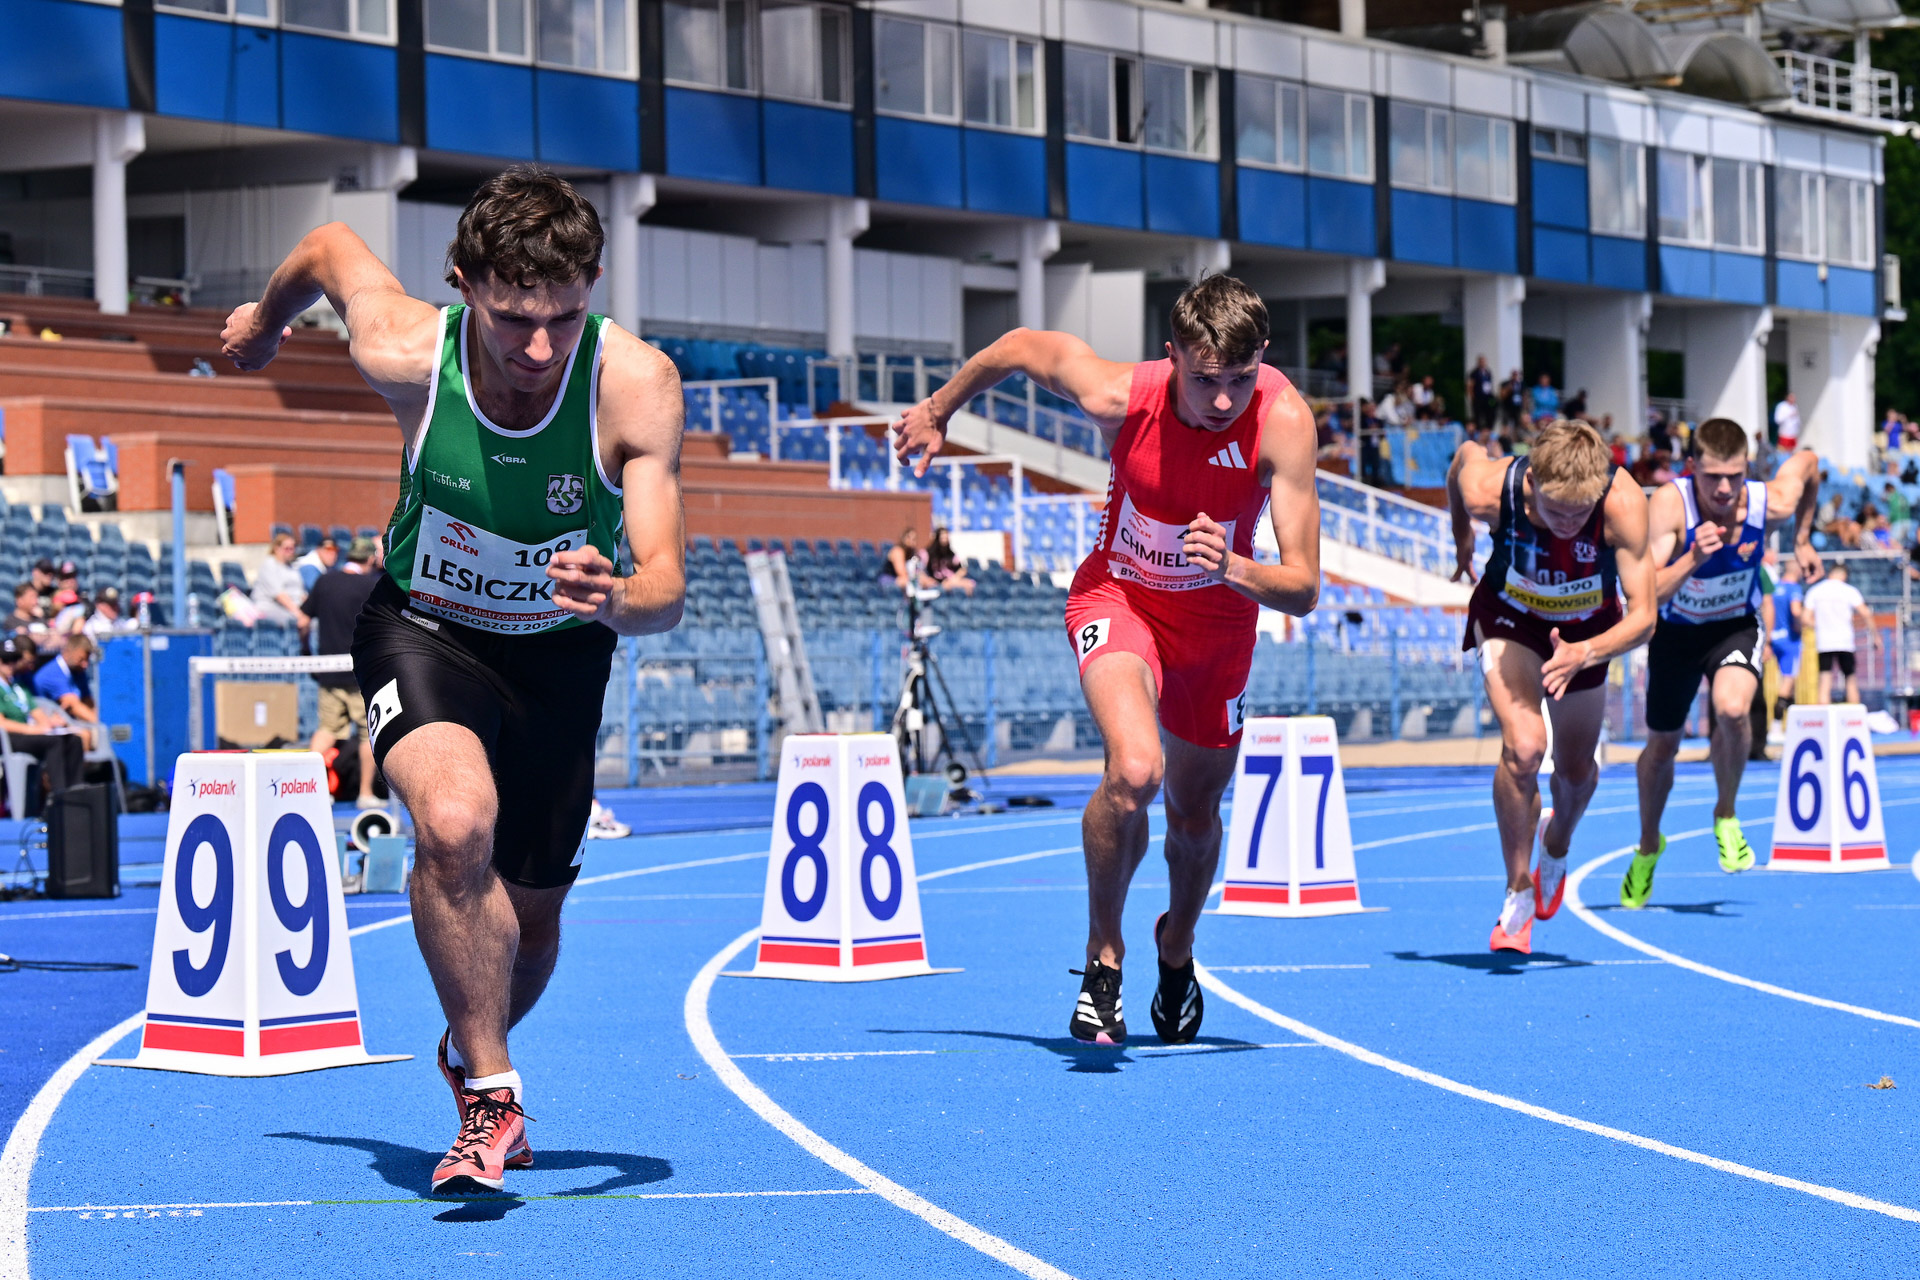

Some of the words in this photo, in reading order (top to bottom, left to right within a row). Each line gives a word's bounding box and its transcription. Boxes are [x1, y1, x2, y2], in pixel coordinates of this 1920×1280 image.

[440, 535, 479, 557] ORLEN
[1120, 527, 1191, 568] CHMIEL
[1120, 567, 1185, 589] BYDGOSZCZ
[1186, 578, 1213, 588] 2025
[1558, 579, 1593, 595] 390
[418, 592, 437, 606] 101.
[439, 599, 466, 612] PZLA
[468, 607, 538, 621] Mistrzostwa
[1508, 589, 1598, 609] OSTROWSKI
[1678, 589, 1745, 608] WYDERKA
[430, 606, 520, 631] BYDGOSZCZ
[523, 619, 559, 631] 2025
[1082, 624, 1098, 654] 8
[199, 779, 236, 798] polanik
[280, 778, 317, 798] polanik
[1788, 738, 1823, 832] 6
[1842, 737, 1871, 831] 6
[1244, 755, 1283, 869] 7
[1300, 755, 1334, 869] 7
[781, 781, 829, 922] 8
[857, 780, 902, 921] 8
[172, 813, 234, 998] 9
[267, 812, 330, 997] 9
